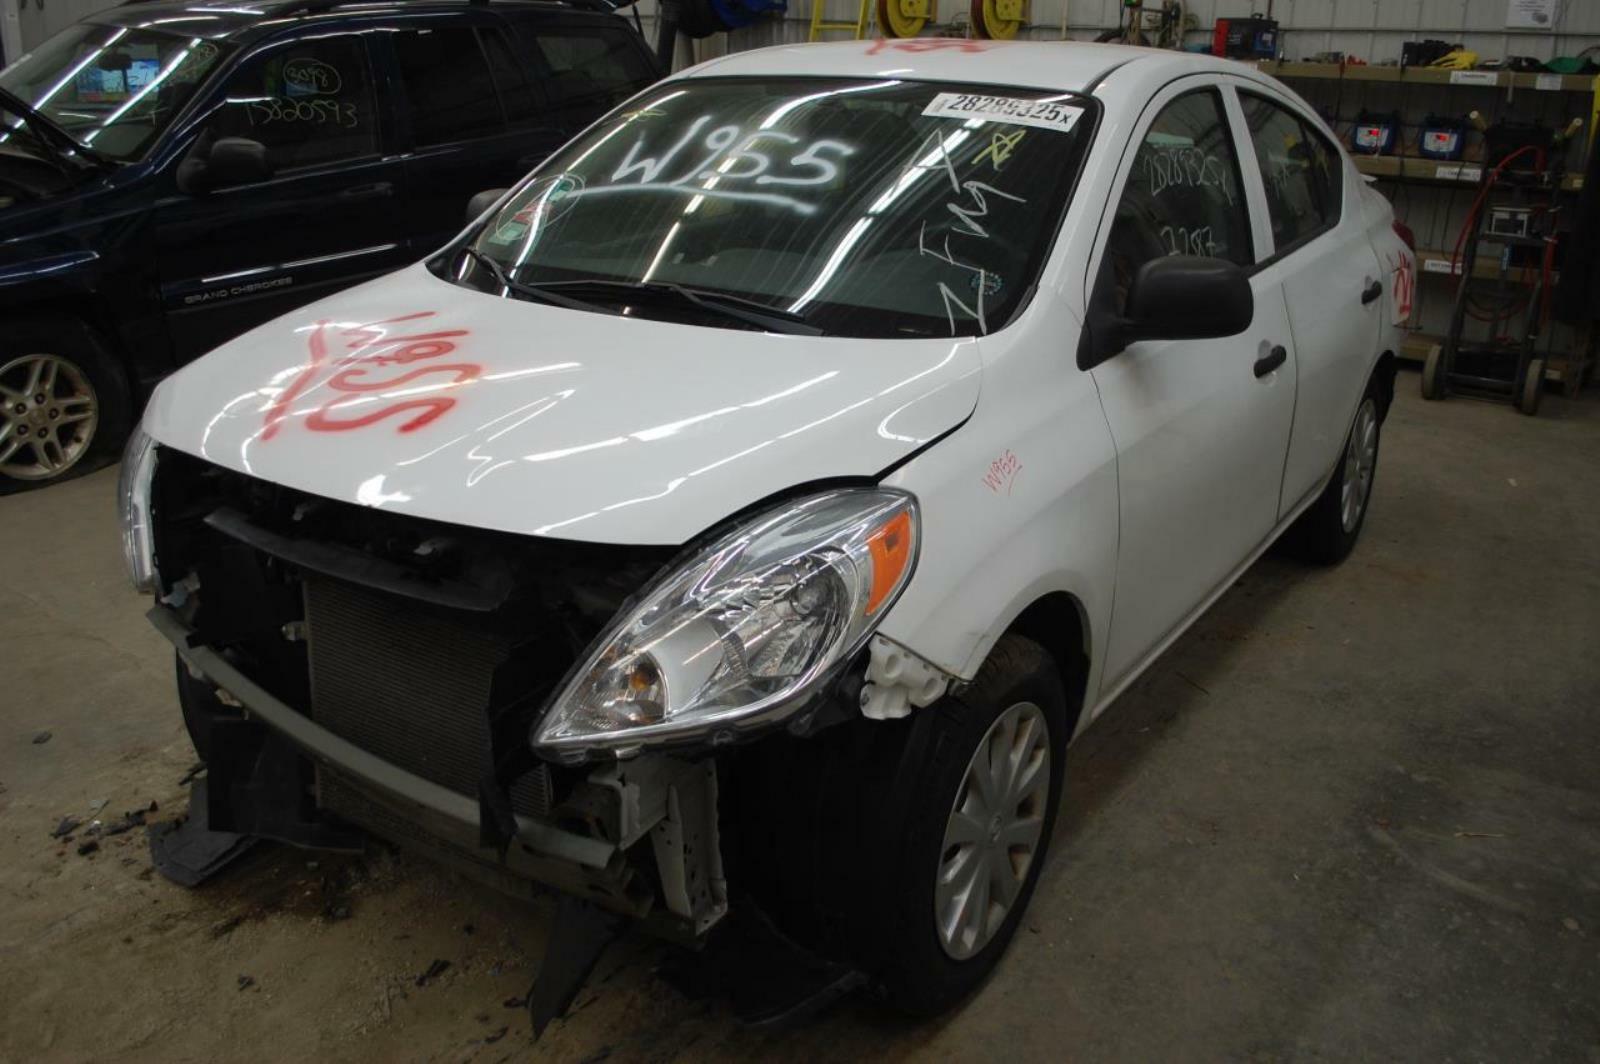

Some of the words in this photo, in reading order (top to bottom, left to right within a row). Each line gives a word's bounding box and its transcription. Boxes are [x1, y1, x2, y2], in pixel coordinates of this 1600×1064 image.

[611, 115, 856, 187] W955
[184, 288, 229, 304] GRAND
[230, 276, 294, 295] CHEROKEE
